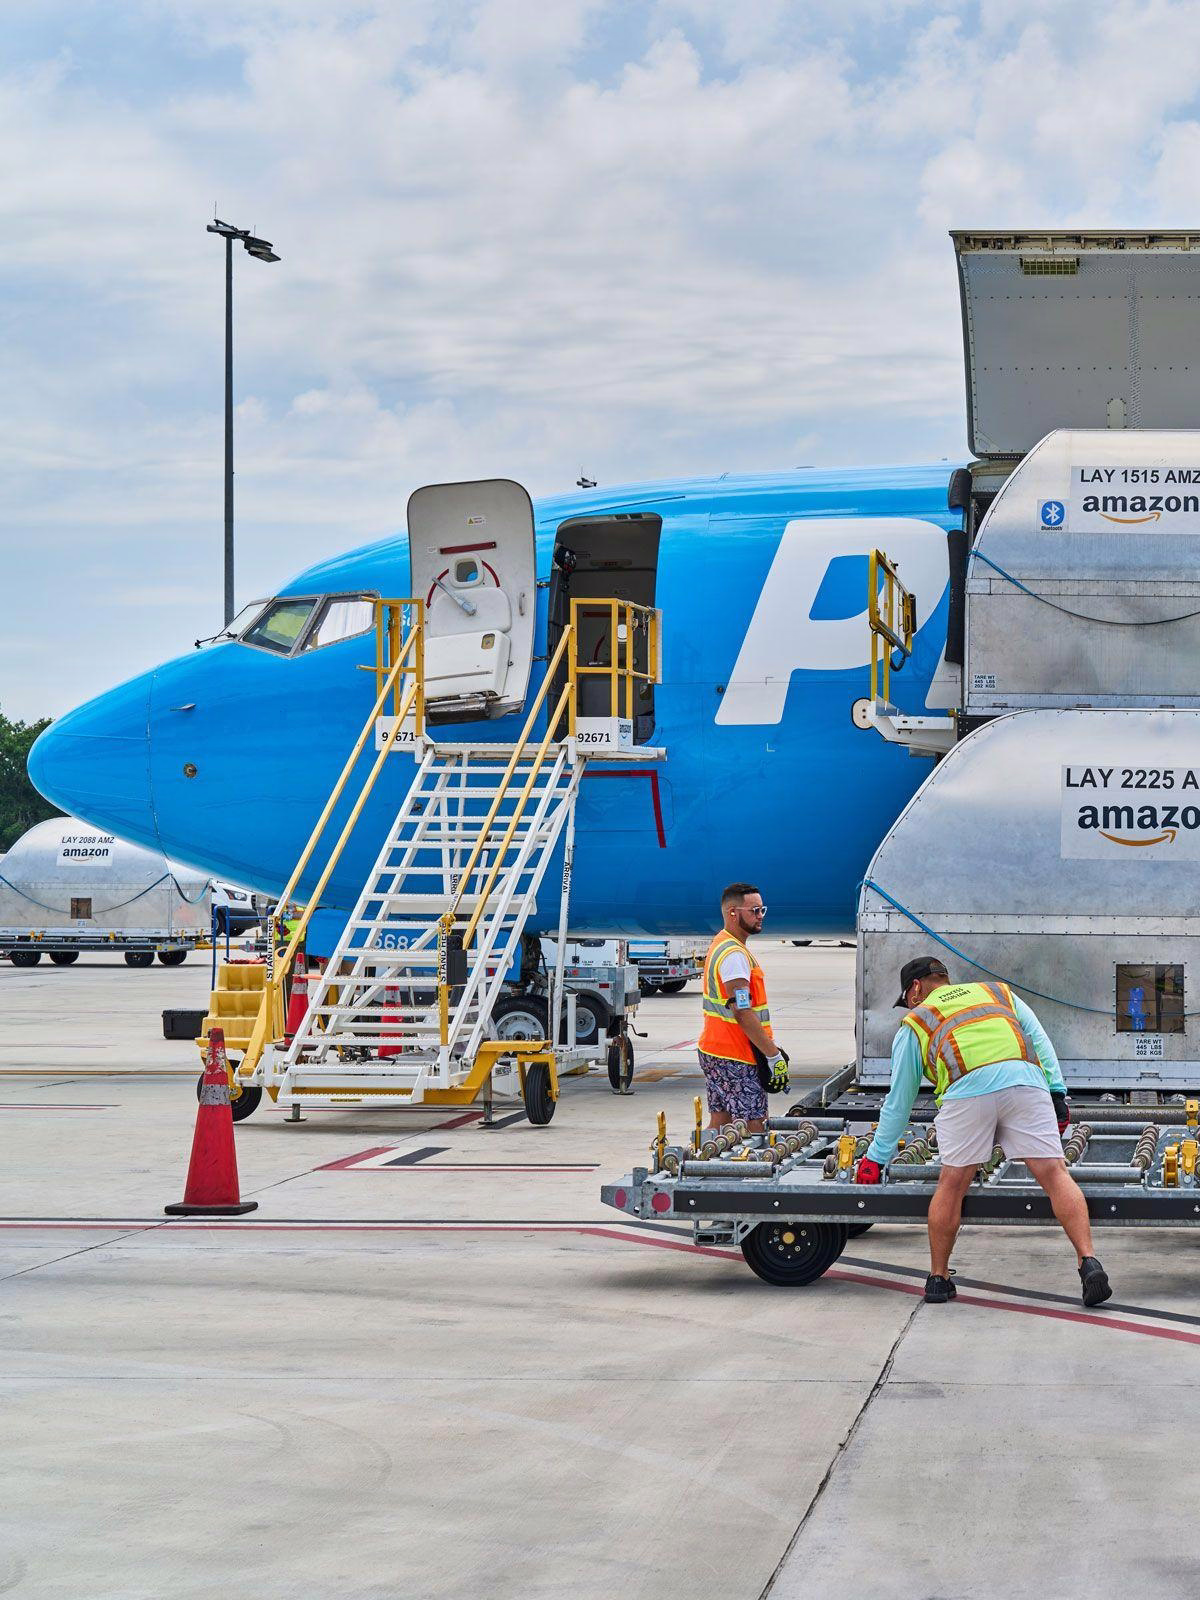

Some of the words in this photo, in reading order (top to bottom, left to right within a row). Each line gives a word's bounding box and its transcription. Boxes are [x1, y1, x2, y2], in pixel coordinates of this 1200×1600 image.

[1081, 469, 1116, 484] LAY
[1121, 469, 1160, 484] 1515
[1082, 495, 1199, 513] amazon
[381, 732, 416, 742] 9671
[577, 732, 611, 743] 92671
[1066, 768, 1114, 788] LAY
[1121, 769, 1175, 789] 2225
[63, 848, 109, 857] amazon
